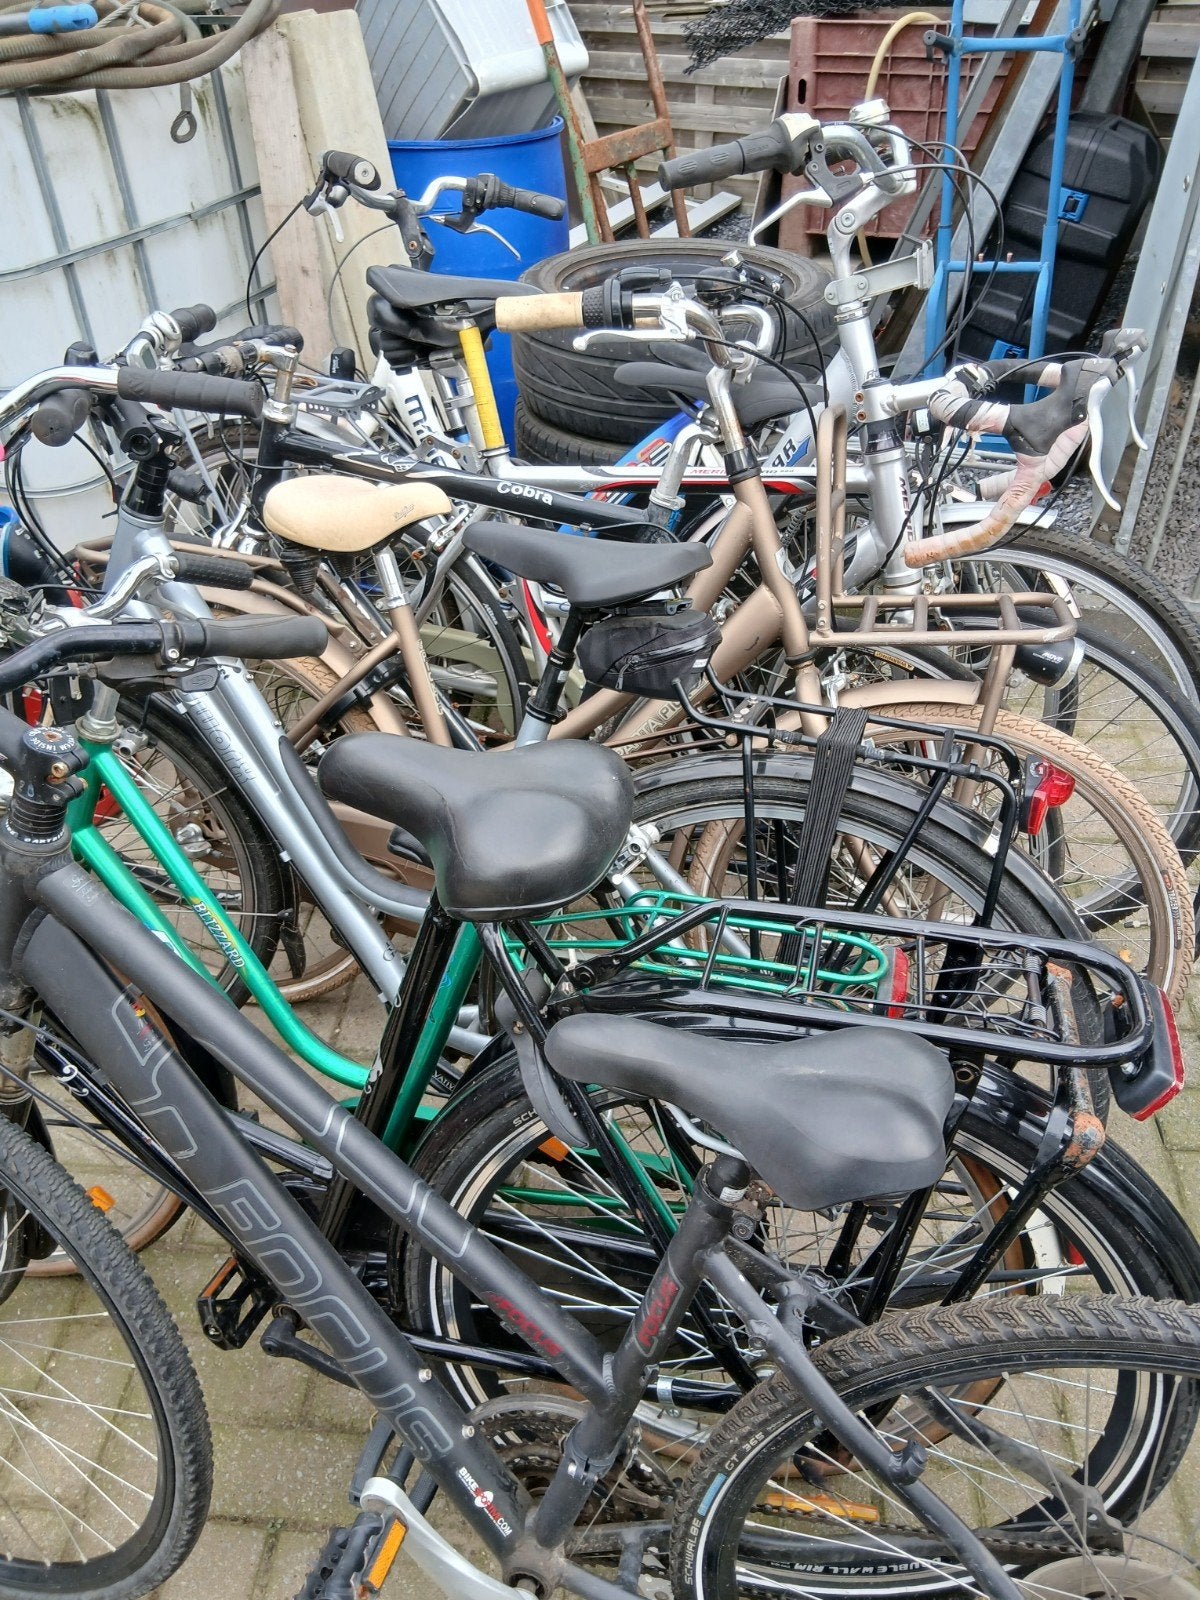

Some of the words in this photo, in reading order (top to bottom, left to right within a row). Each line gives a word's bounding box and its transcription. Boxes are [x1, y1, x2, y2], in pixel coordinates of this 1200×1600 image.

[496, 480, 553, 506] Cobra
[192, 901, 245, 968] BLIZZARD
[512, 1107, 539, 1127] SCH
[684, 1517, 702, 1586] SCHWALBE
[725, 1453, 740, 1472] GT
[742, 1431, 765, 1454] 365
[793, 1562, 825, 1574] RIM
[829, 1565, 873, 1575] WALL
